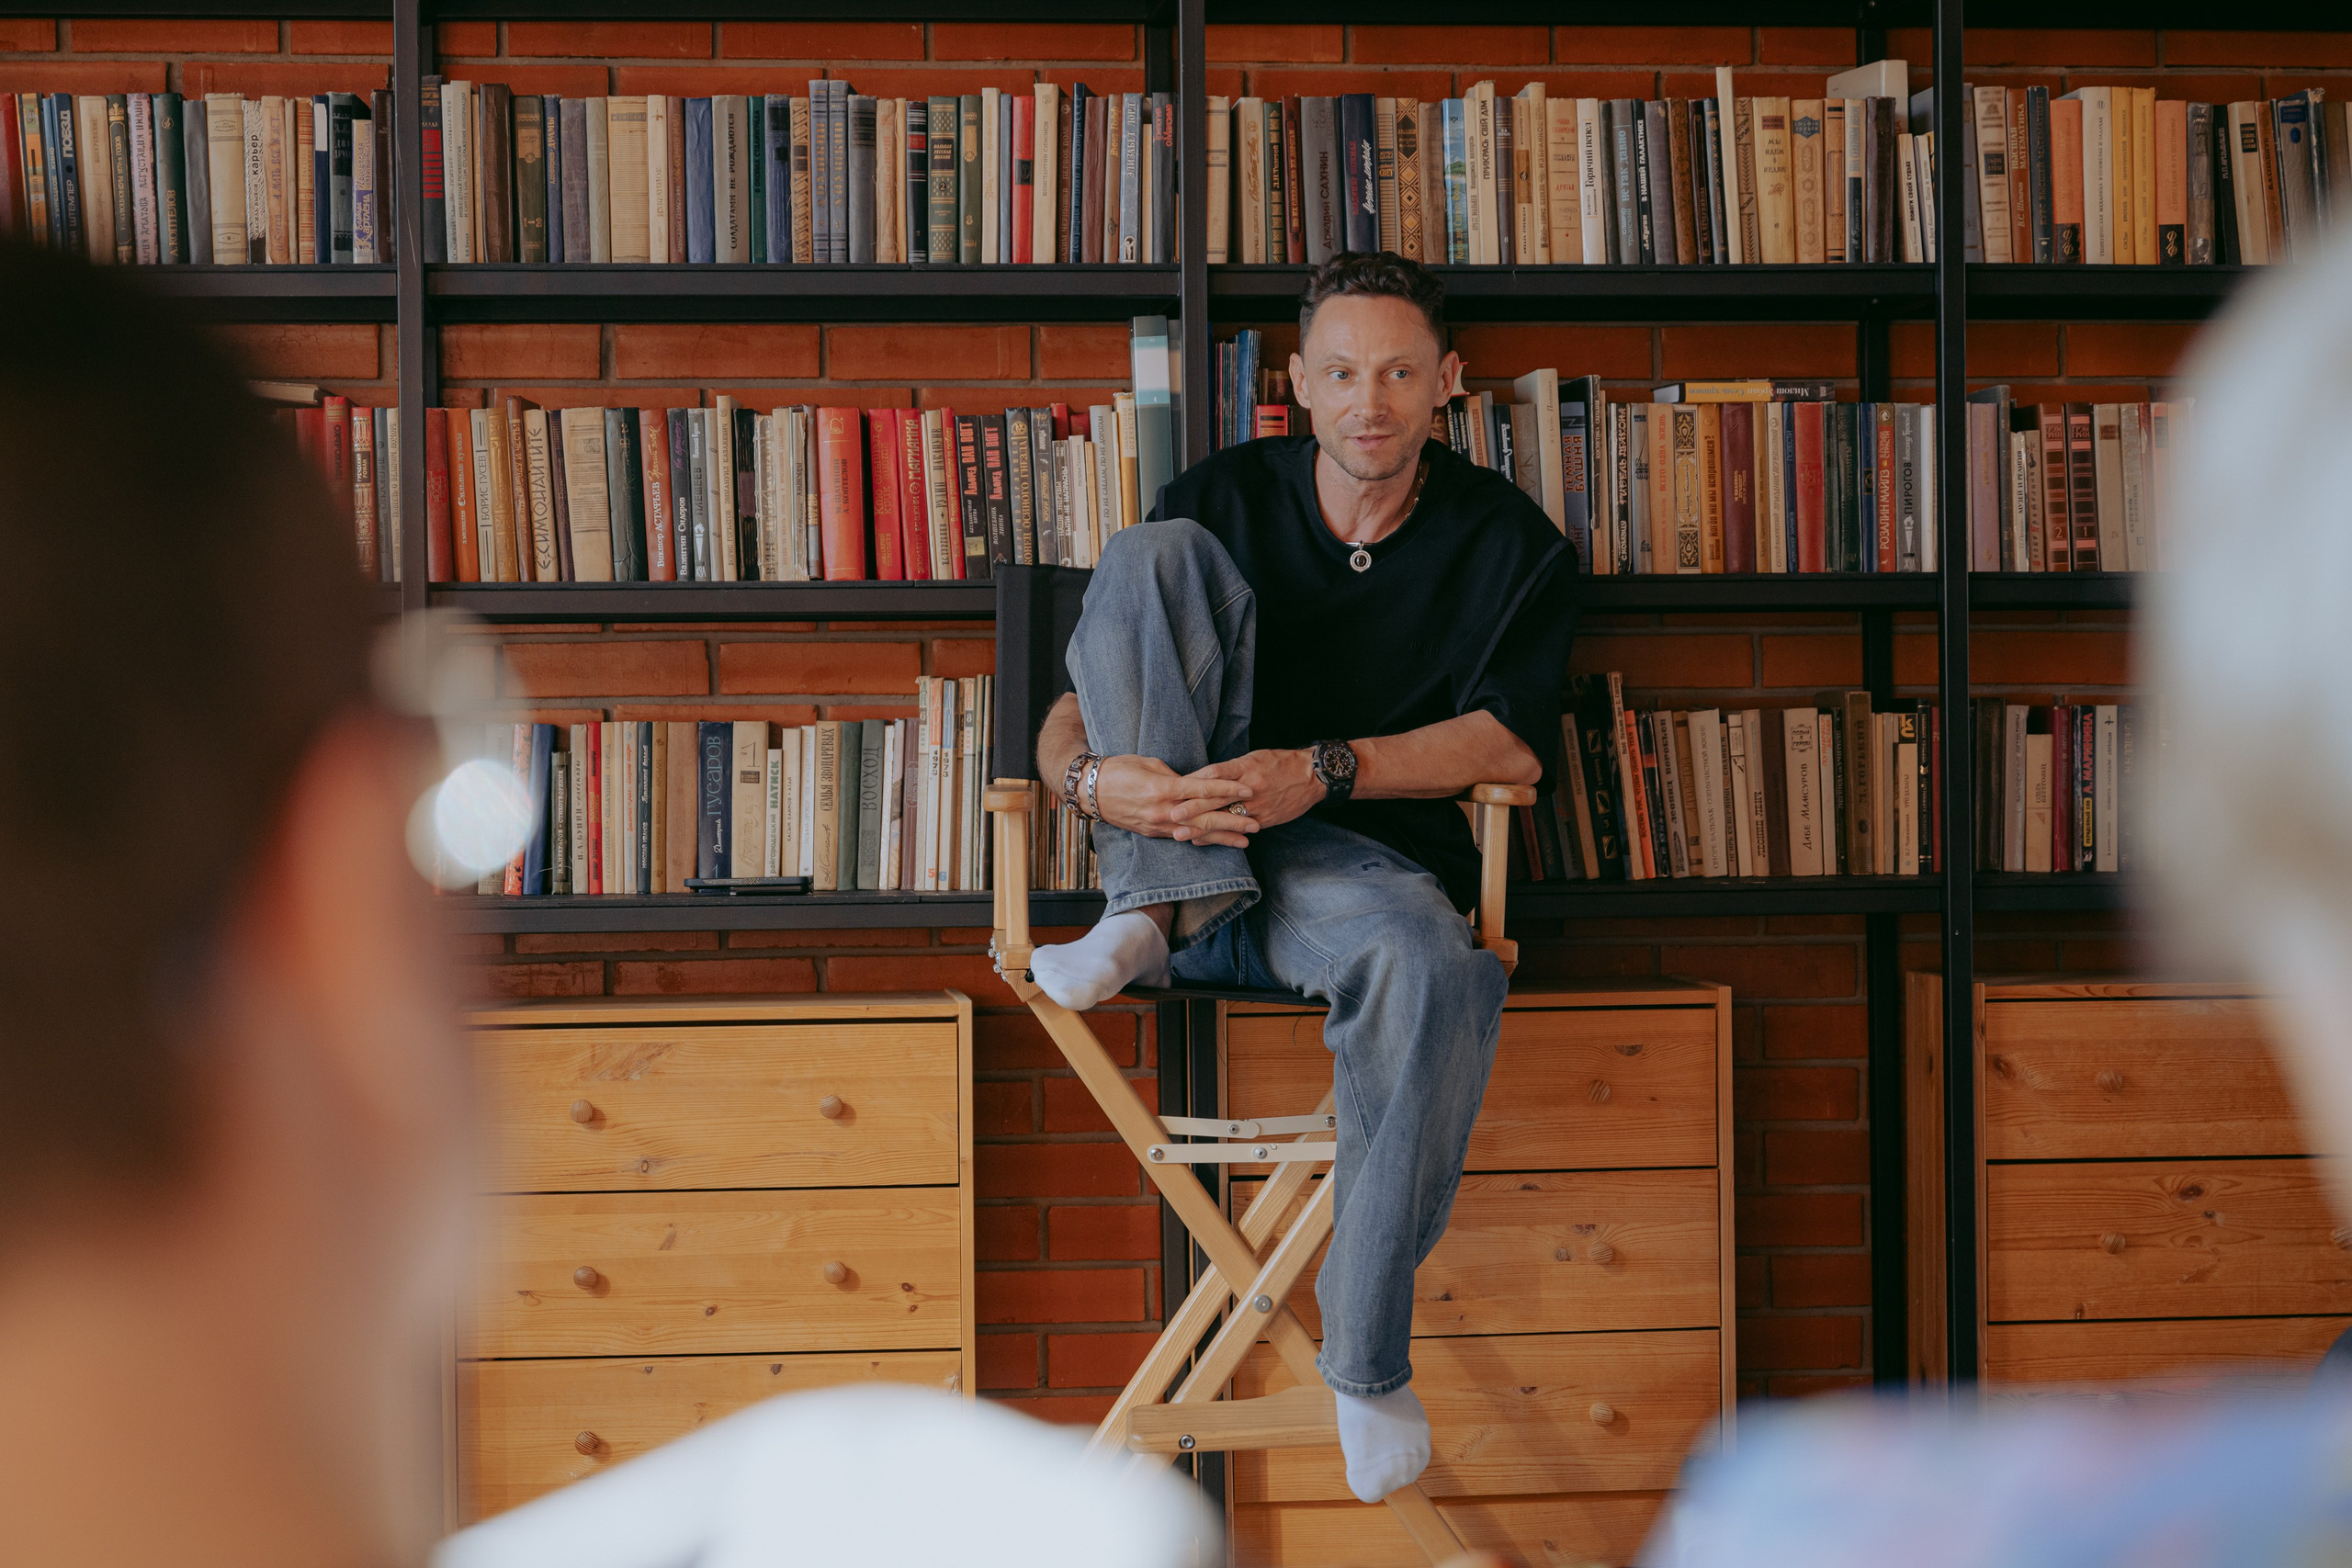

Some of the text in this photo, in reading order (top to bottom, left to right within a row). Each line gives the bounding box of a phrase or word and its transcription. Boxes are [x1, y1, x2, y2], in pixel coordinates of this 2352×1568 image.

[547, 117, 555, 149] ДРАМЫ
[1110, 107, 1120, 130] Гофф
[1154, 107, 1163, 142] Трилогия
[1480, 118, 1489, 136] СВІЙ
[2018, 103, 2026, 169] МАТЕМАТИКА
[251, 135, 259, 175] карьер
[1127, 102, 1136, 177] ЭЛИЗАБЕТ ЛОРД
[1585, 122, 1595, 187] Горячий пепел
[1765, 149, 1784, 157] ИДЕМ
[60, 109, 76, 226] ШТЕМЛЕР ПОЕЗД
[728, 113, 738, 249] СОЛДАТАМИ НЕ РОЖДАЮТСЯ
[1272, 145, 1280, 188] Л.Н.Толстой
[1618, 130, 1630, 201] не так давно
[1638, 166, 1646, 195] НАШЕЙ
[1764, 167, 1786, 175] ИНДИЮ
[655, 168, 663, 217] ИЗБРАННОЕ
[1319, 152, 1332, 249] Аркадий САХНИН
[522, 217, 542, 228] 1-2
[1777, 386, 1810, 396] Милош
[945, 427, 955, 449] свободу
[961, 423, 974, 442] ВОГТ
[985, 427, 998, 446] ВОГТ
[1657, 413, 1666, 440] ЖИЗНЬ
[906, 420, 922, 479] МАРИАННА
[931, 428, 947, 508] РУДИН НАКАНУНЕ
[963, 446, 975, 463] ВАН
[988, 450, 1000, 468] ВАН
[1100, 446, 1105, 456] ИХ
[1101, 457, 1106, 467] ПО
[1564, 435, 1574, 492] ТЕМНАЯ
[1573, 435, 1585, 491] БАШНЯ
[1618, 407, 1627, 504] ГИБЕЛЬ ДРАКОНА
[479, 456, 490, 520] БОРИС ГУСЕВ
[695, 468, 703, 515] ПЛЕШЕЕВ
[873, 434, 883, 514] Кто слышал
[881, 443, 892, 514] крик аиста
[1904, 462, 1913, 514] ПИРОГОВ
[652, 482, 663, 532] АСТАФЬЕВ
[678, 497, 687, 532] Сидоров
[950, 496, 958, 515] первых
[1019, 441, 1033, 565] КОНЕЦ ОСИНОГО ГНЕЗДА
[1064, 504, 1069, 513] НЕ
[1103, 497, 1108, 506] ИХ
[1103, 508, 1109, 518] ПО
[1879, 469, 1889, 549] РОЗАЛИН МАЙЛЗ
[990, 506, 999, 544] ВОЛШЕБНИК
[655, 534, 664, 567] Виктор
[1567, 728, 1583, 795] РАЗГОВОР ПО ДУШАМ
[1702, 750, 1710, 780] ЧАСТНОЙ
[2084, 713, 2093, 780] МАРИНИНА
[770, 761, 779, 808] НАТИСК
[820, 728, 834, 811] СЕМЬЯ ЗВОНАРЕВЫХ
[862, 747, 880, 810] ВОСХОД
[1708, 808, 1717, 840] БАЛЬЗАК
[1754, 791, 1765, 857] ЛЕОНИД ЛЕНЧ
[1801, 763, 1812, 850] ДАБЕ МАМСУРОВ
[713, 818, 723, 852] Дмитрий
[928, 869, 935, 879] 5
